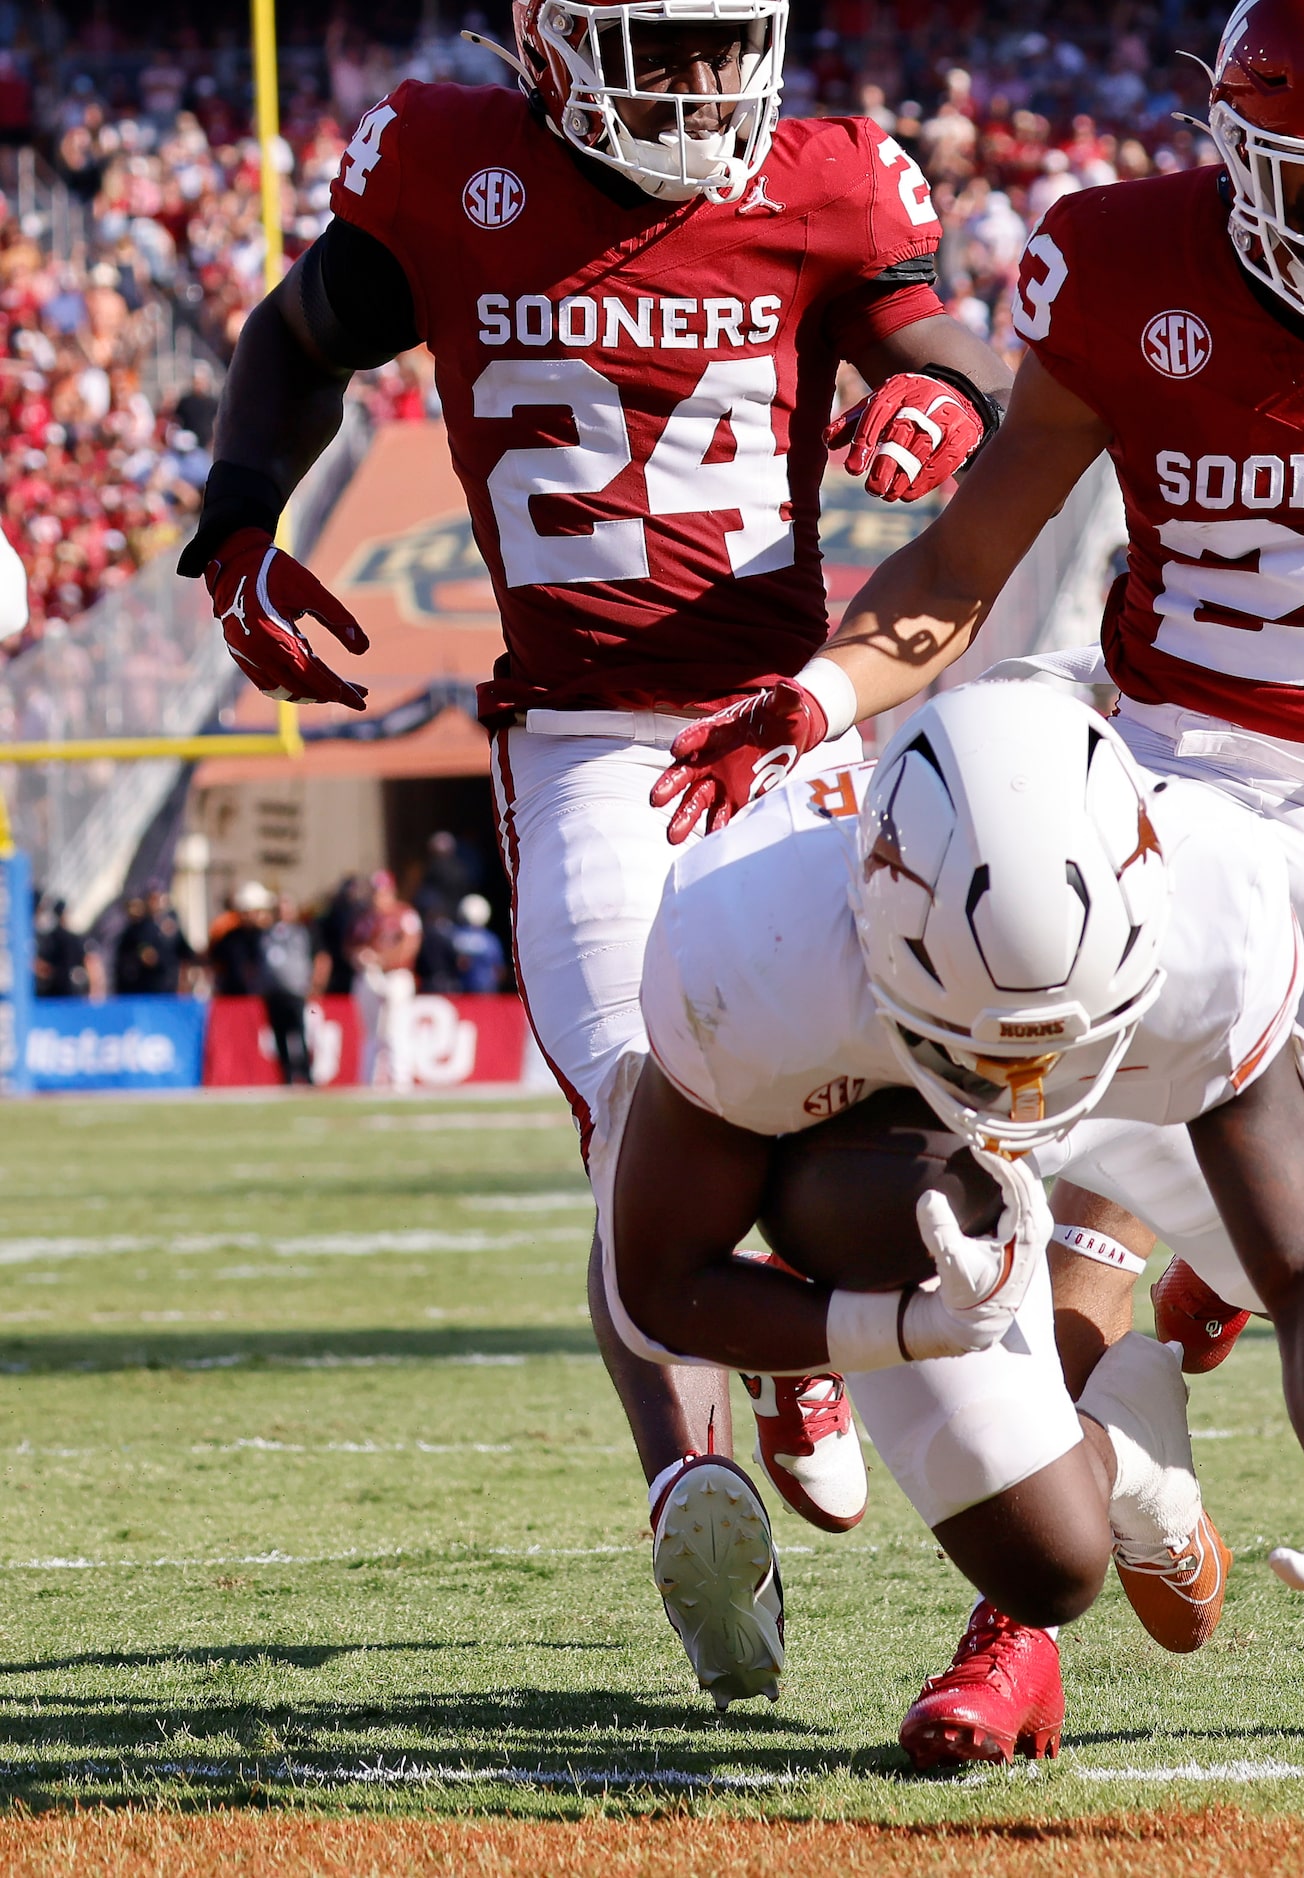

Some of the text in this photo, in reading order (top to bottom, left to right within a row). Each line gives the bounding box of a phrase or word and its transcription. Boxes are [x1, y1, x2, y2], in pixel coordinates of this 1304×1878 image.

[338, 96, 398, 196] 4
[467, 171, 520, 225] SEC
[876, 136, 938, 226] 2
[1012, 216, 1069, 342] 3
[476, 293, 782, 350] SOONERS
[1146, 314, 1205, 375] SEC
[472, 355, 797, 588] 24
[25, 1027, 174, 1076] llstate
[1000, 1020, 1066, 1038] HORNS
[1064, 1229, 1126, 1264] JORDAN
